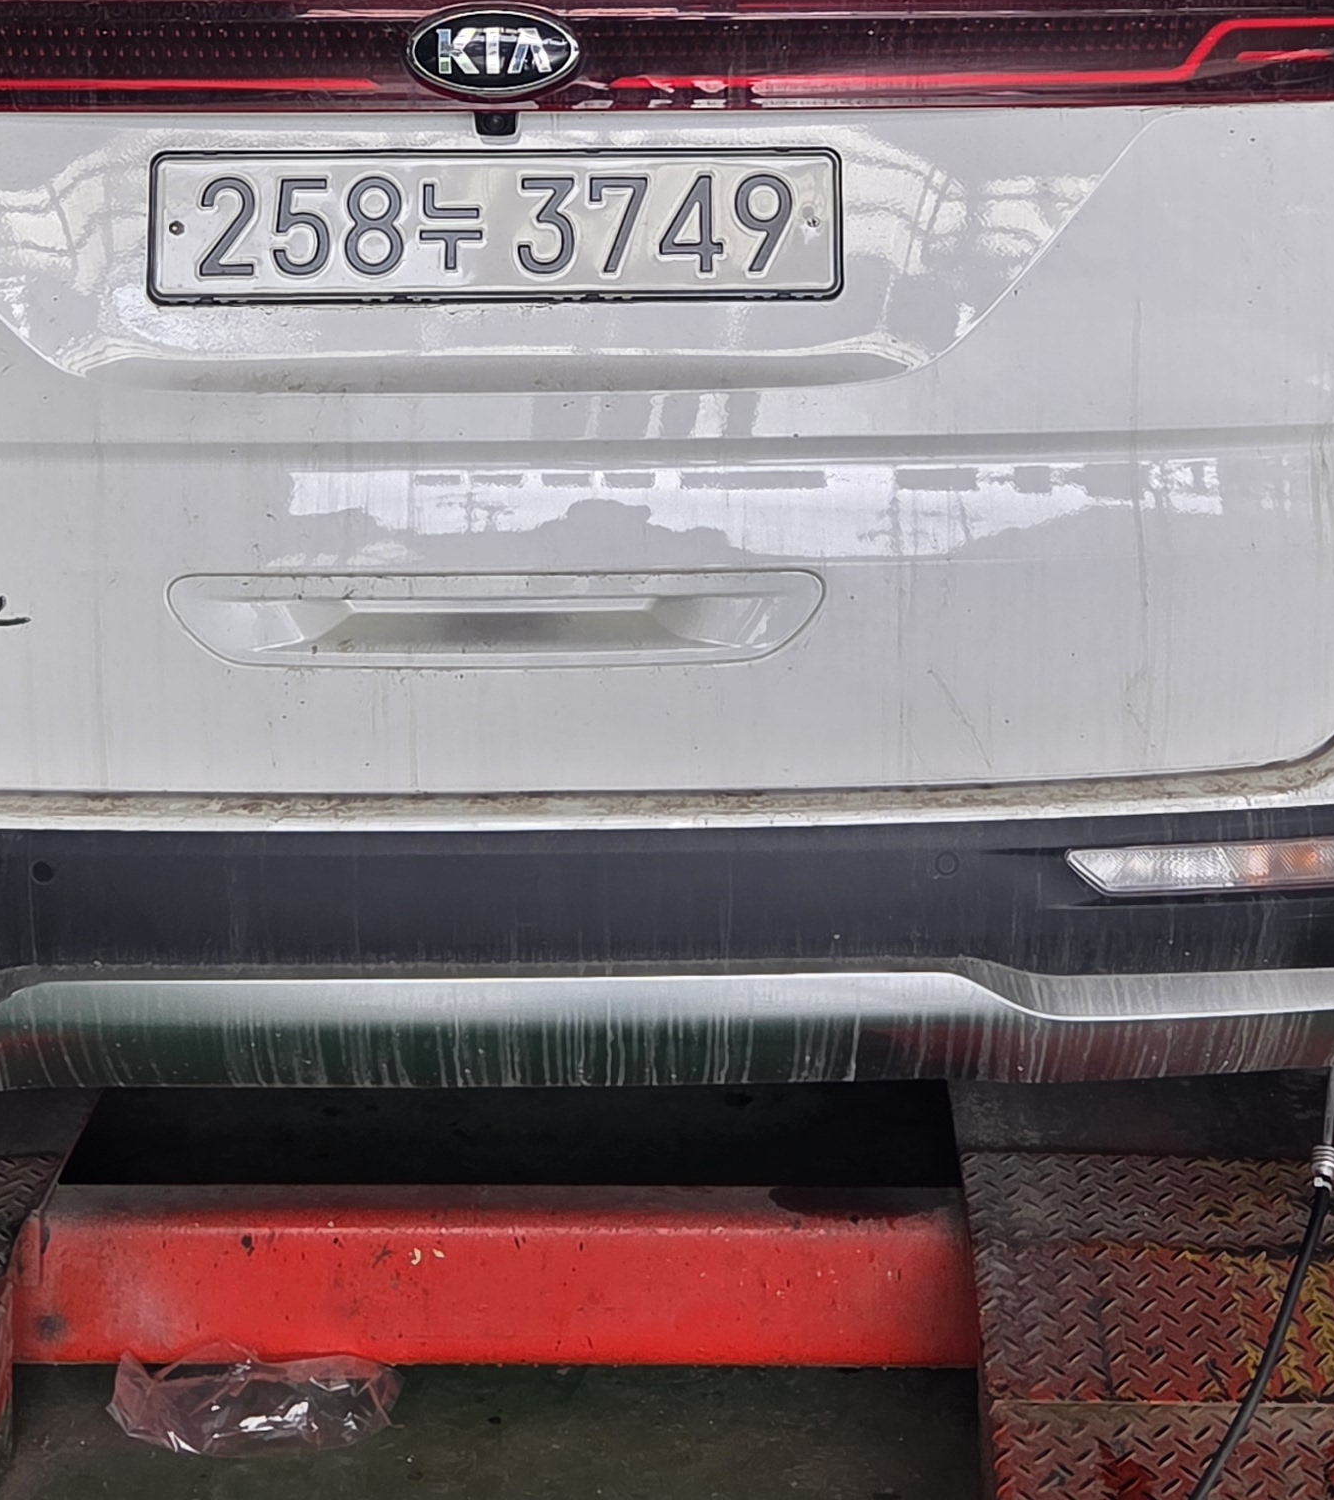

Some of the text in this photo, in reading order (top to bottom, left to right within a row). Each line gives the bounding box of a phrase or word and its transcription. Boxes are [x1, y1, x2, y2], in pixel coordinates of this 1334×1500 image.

[436, 27, 552, 74] KIA
[198, 173, 794, 277] 258누 3749
